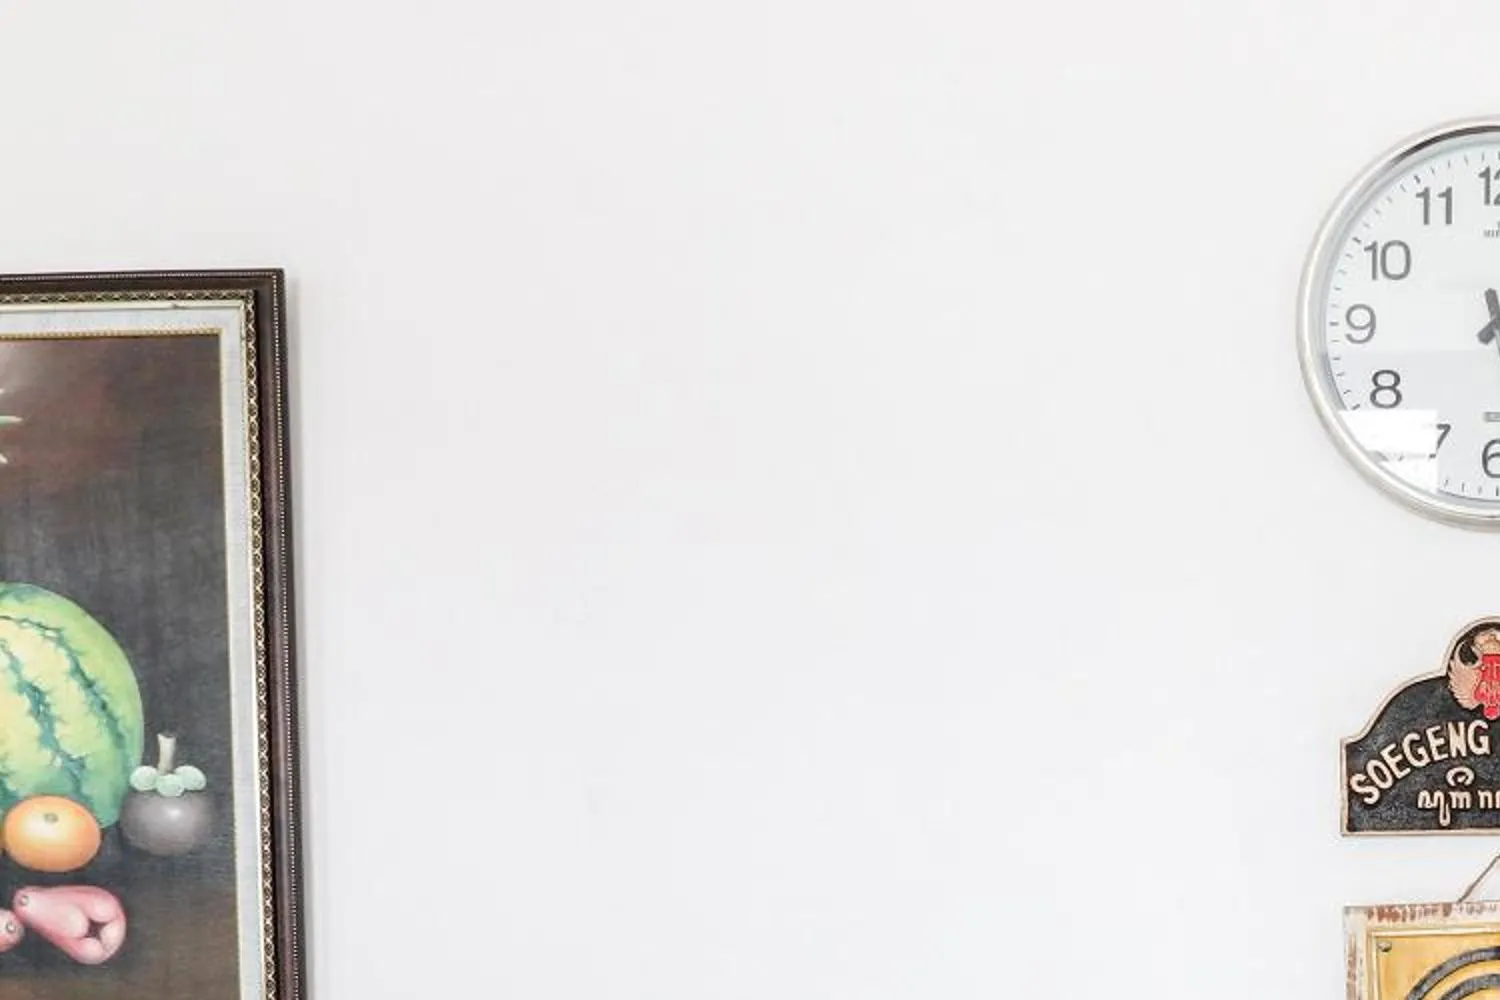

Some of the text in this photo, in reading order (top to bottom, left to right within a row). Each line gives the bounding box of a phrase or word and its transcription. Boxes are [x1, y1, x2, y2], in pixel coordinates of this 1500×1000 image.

[1415, 186, 1453, 225] 11
[1363, 239, 1412, 281] 10
[1345, 303, 1377, 344] 9
[1369, 369, 1403, 410] 8
[1350, 720, 1489, 805] SOEGENG
